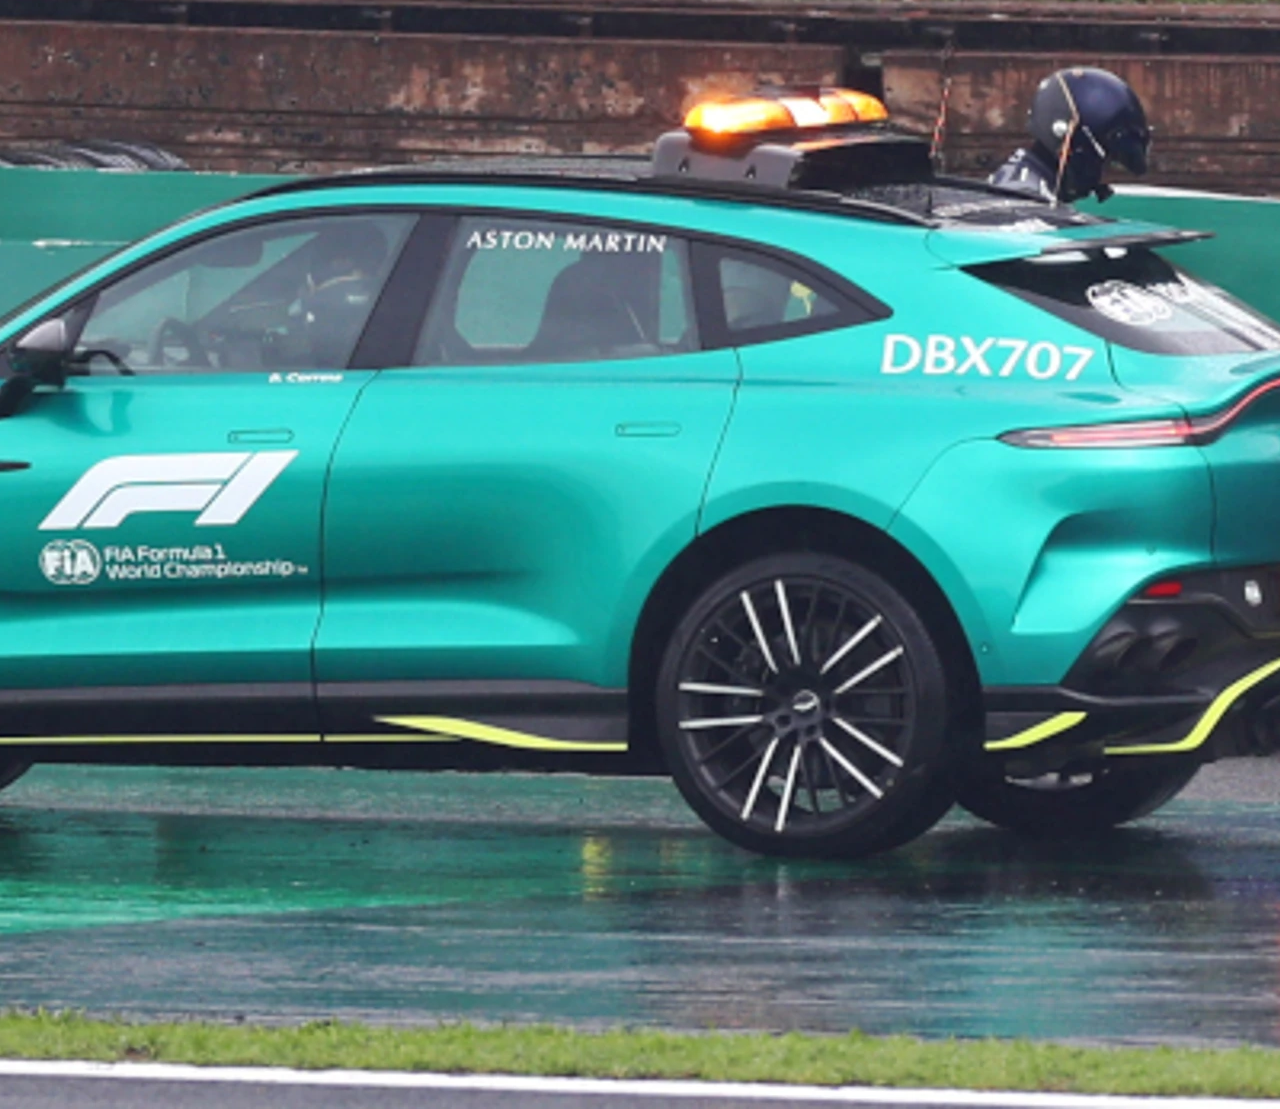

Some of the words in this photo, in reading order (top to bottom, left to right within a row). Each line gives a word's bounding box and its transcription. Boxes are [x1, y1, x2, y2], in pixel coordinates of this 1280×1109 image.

[466, 230, 555, 250] ASTON
[563, 232, 668, 252] MARTIN
[880, 333, 1095, 381] DBX707
[103, 546, 136, 562] FIA
[137, 544, 212, 562] Formula
[214, 543, 227, 560] 1
[105, 562, 162, 580] World
[163, 558, 295, 581] Championship
